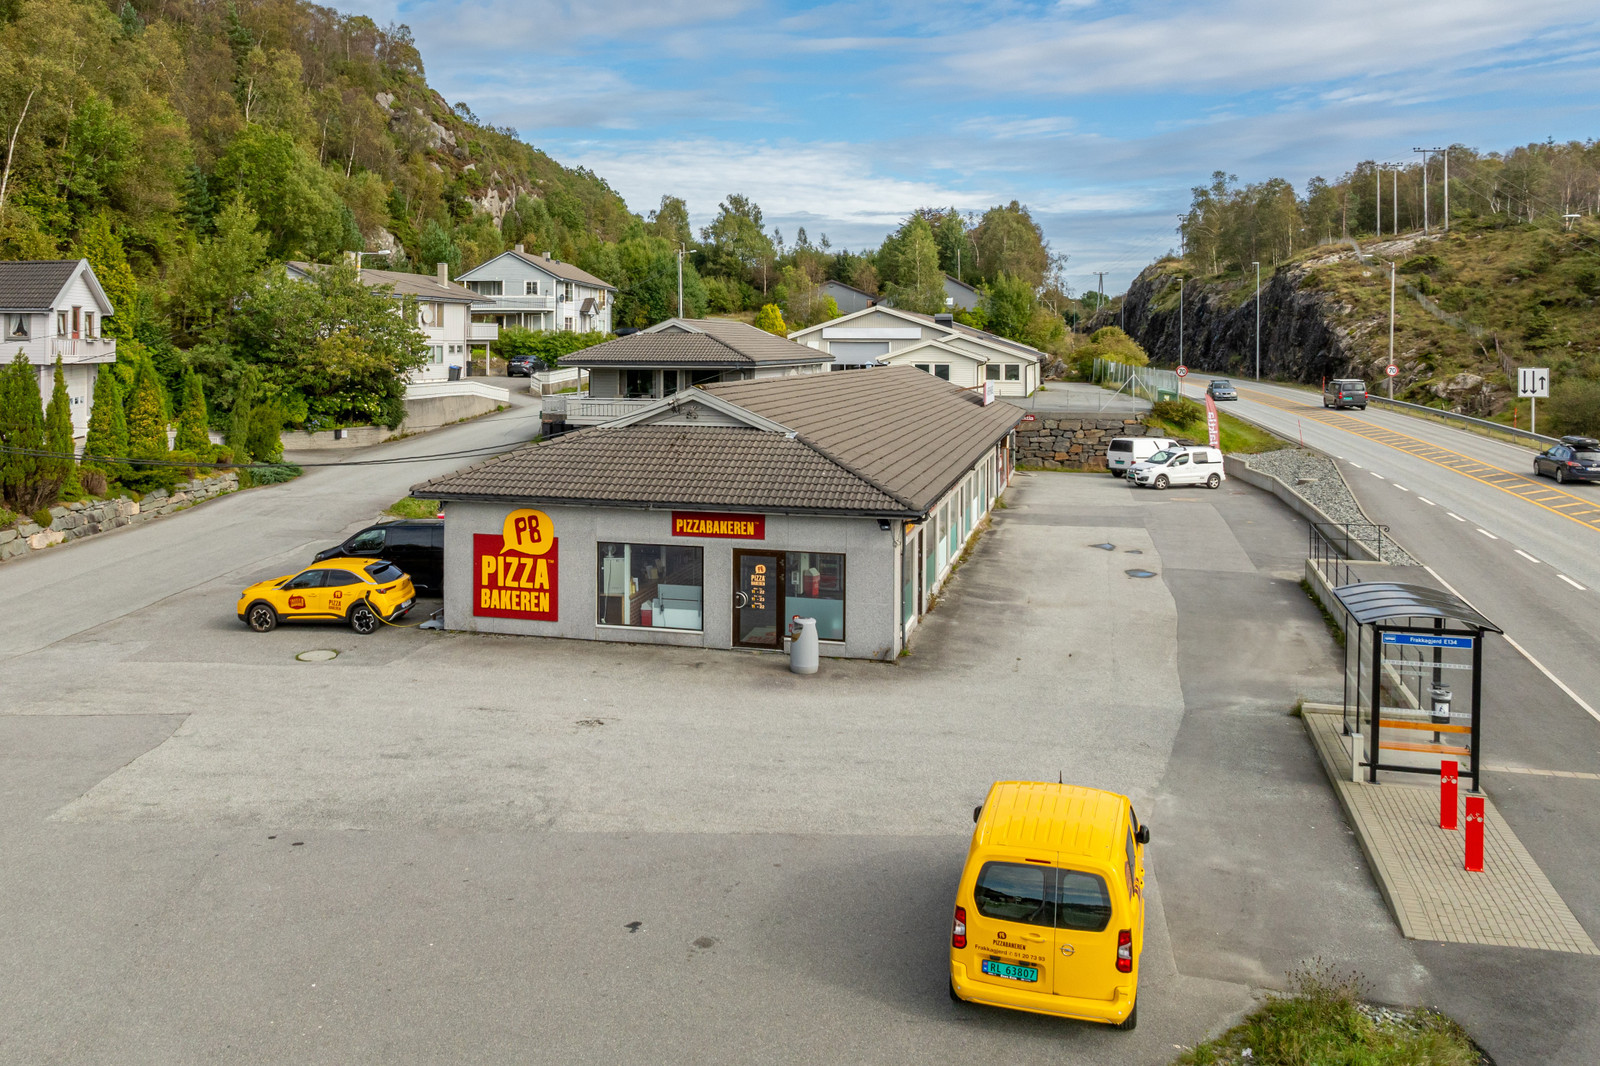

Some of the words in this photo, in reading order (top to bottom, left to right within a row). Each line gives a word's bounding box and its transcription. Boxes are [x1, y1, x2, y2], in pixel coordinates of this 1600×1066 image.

[514, 515, 541, 545] PB
[481, 554, 550, 590] PIZZA
[480, 588, 550, 612] BAKEREN
[993, 940, 1026, 950] PIZZABAKEREN
[990, 963, 1000, 973] RL
[1006, 966, 1035, 979] 63807
